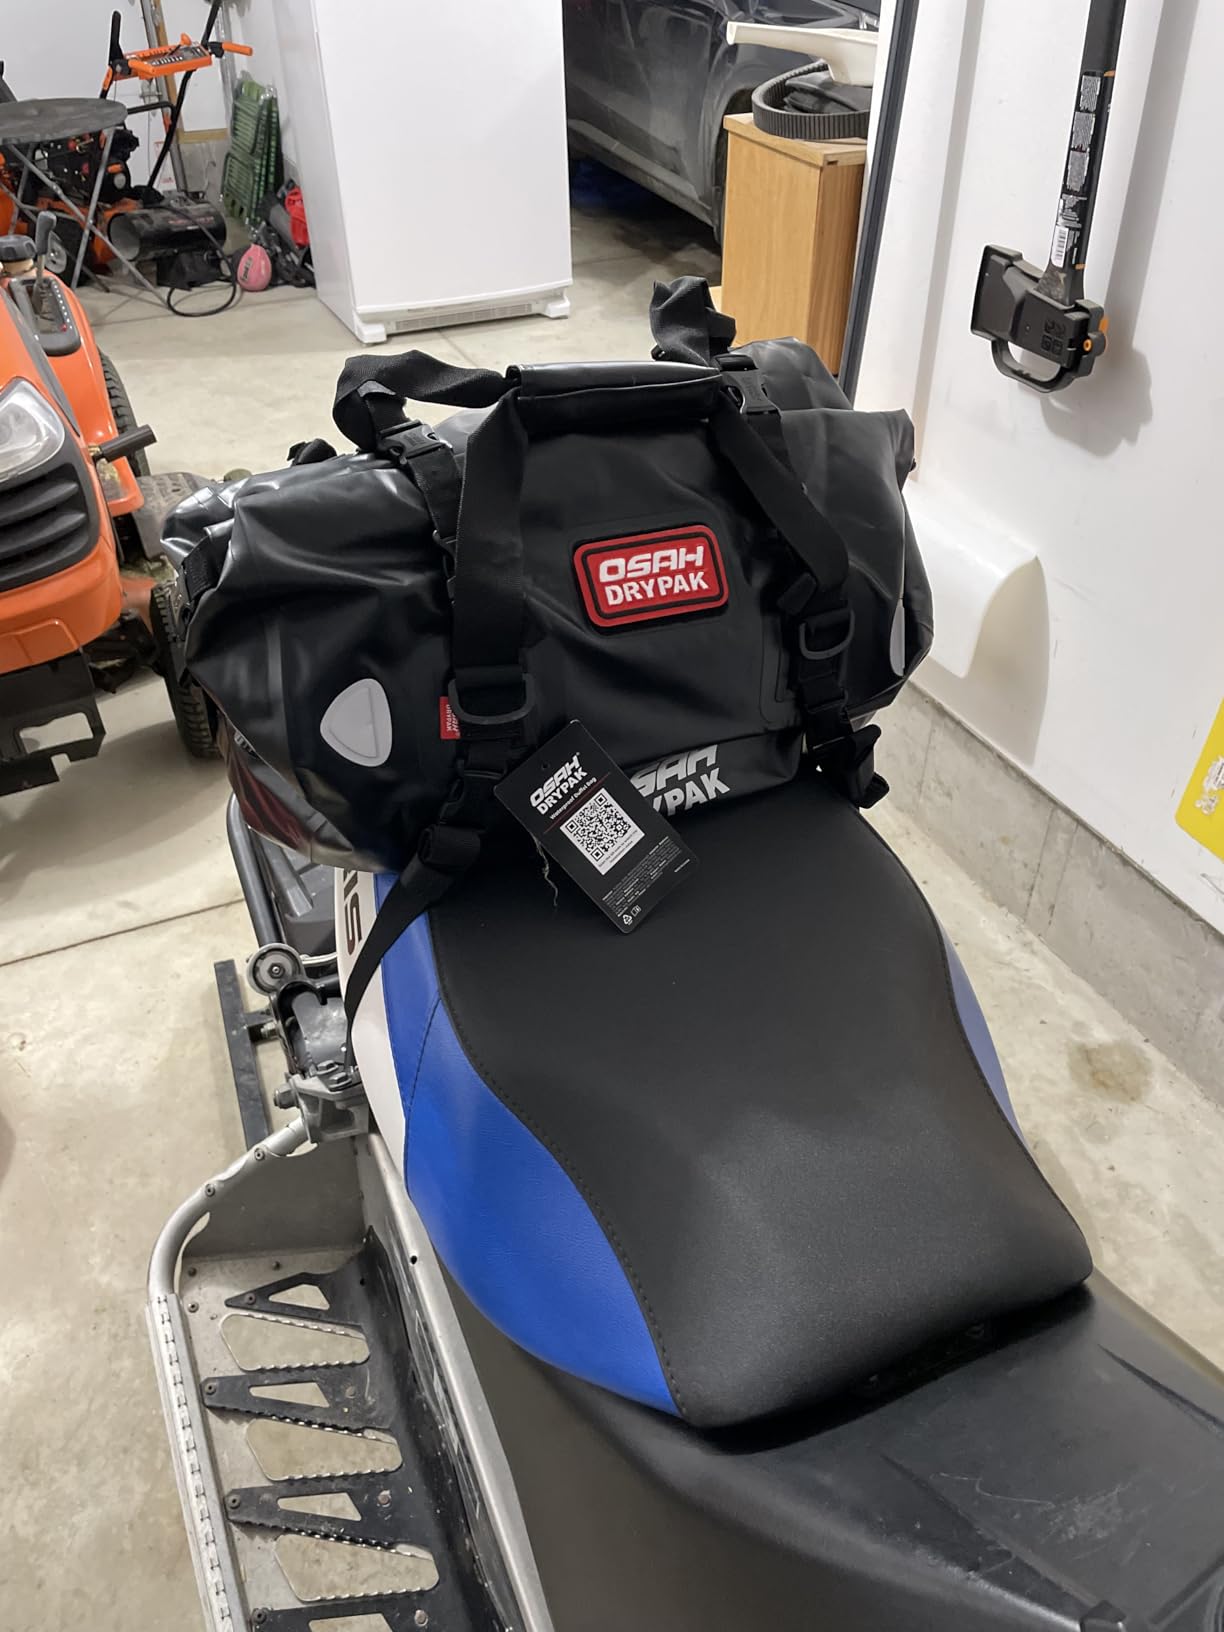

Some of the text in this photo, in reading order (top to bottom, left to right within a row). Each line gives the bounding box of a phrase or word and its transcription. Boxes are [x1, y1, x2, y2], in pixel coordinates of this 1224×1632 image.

[599, 545, 704, 583] OSAH
[604, 571, 709, 606] DRYPAK
[530, 755, 580, 808] OSAH
[536, 767, 588, 815] DRYPAK
[630, 744, 718, 797] SAH
